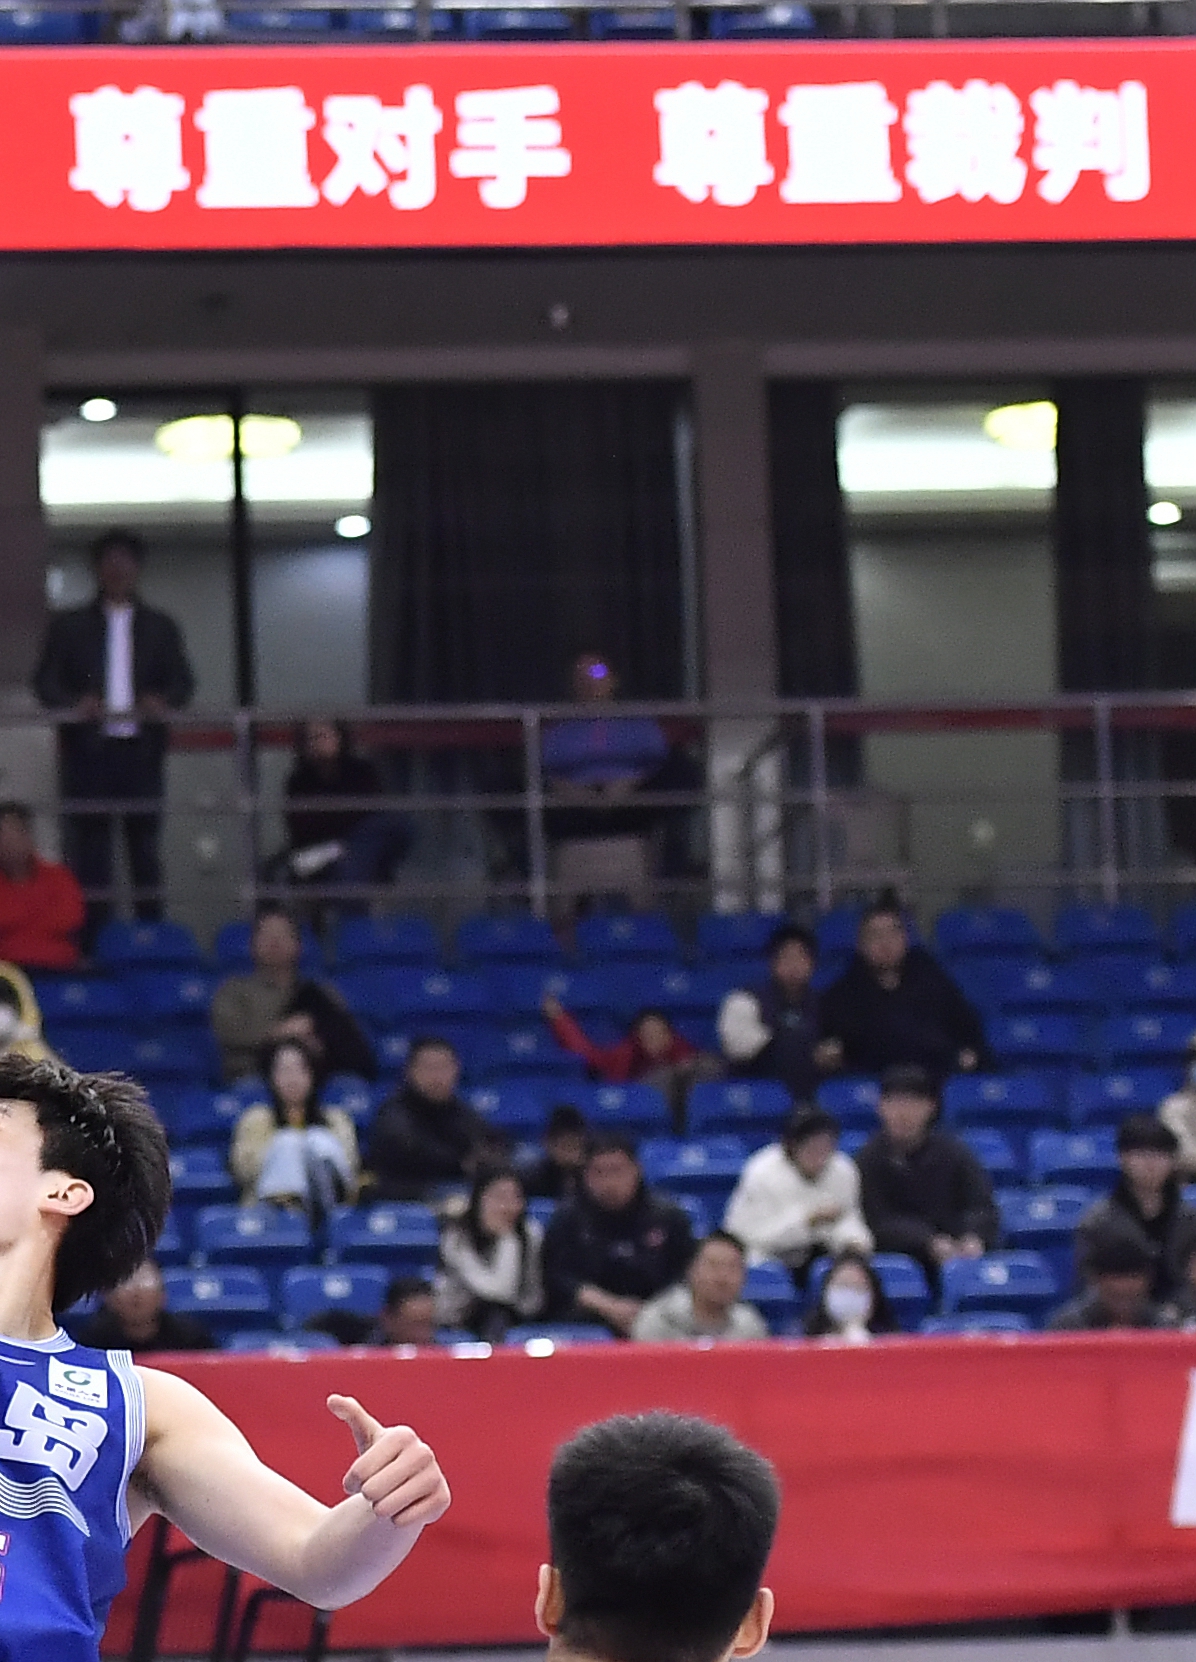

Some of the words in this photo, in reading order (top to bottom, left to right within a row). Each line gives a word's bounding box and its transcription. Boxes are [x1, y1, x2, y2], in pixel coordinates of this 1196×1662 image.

[69, 83, 572, 212] 尊重对手
[653, 79, 1152, 206] 尊重裁判
